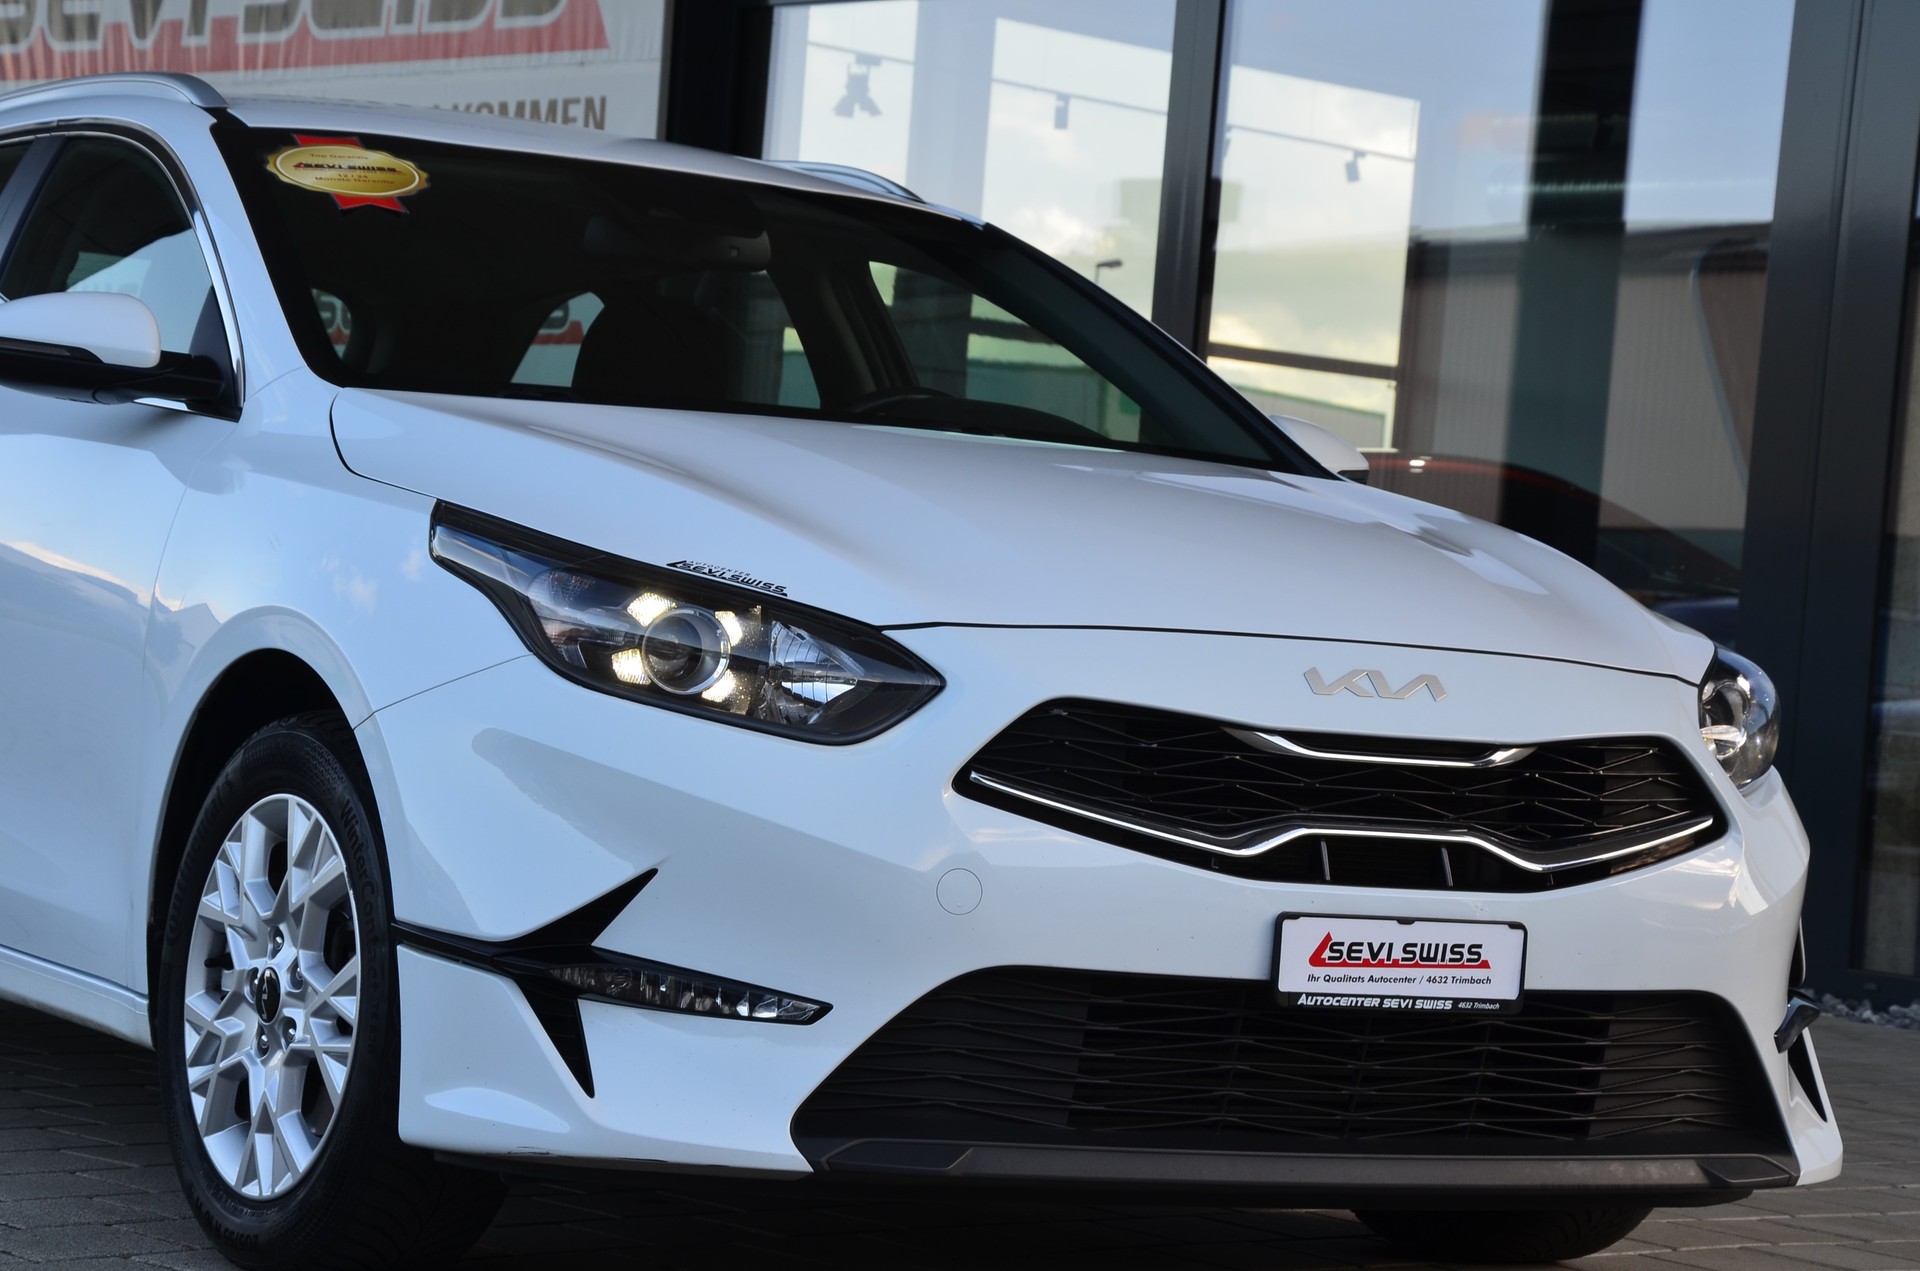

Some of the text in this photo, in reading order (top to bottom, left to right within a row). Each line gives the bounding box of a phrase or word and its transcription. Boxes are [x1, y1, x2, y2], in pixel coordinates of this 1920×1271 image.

[690, 560, 751, 576] AUTOCENTER
[1304, 667, 1447, 702] KIA
[1326, 941, 1483, 964] SEVI SWISS
[1307, 974, 1321, 982] Ihr
[1323, 974, 1365, 984] Qualitats
[1367, 975, 1417, 984] Autocenter
[1426, 975, 1448, 984] 4632
[1451, 976, 1492, 985] Trimbach
[1298, 993, 1500, 1010] AUTOCENTER SEVI SWISS 4632 Trimbach
